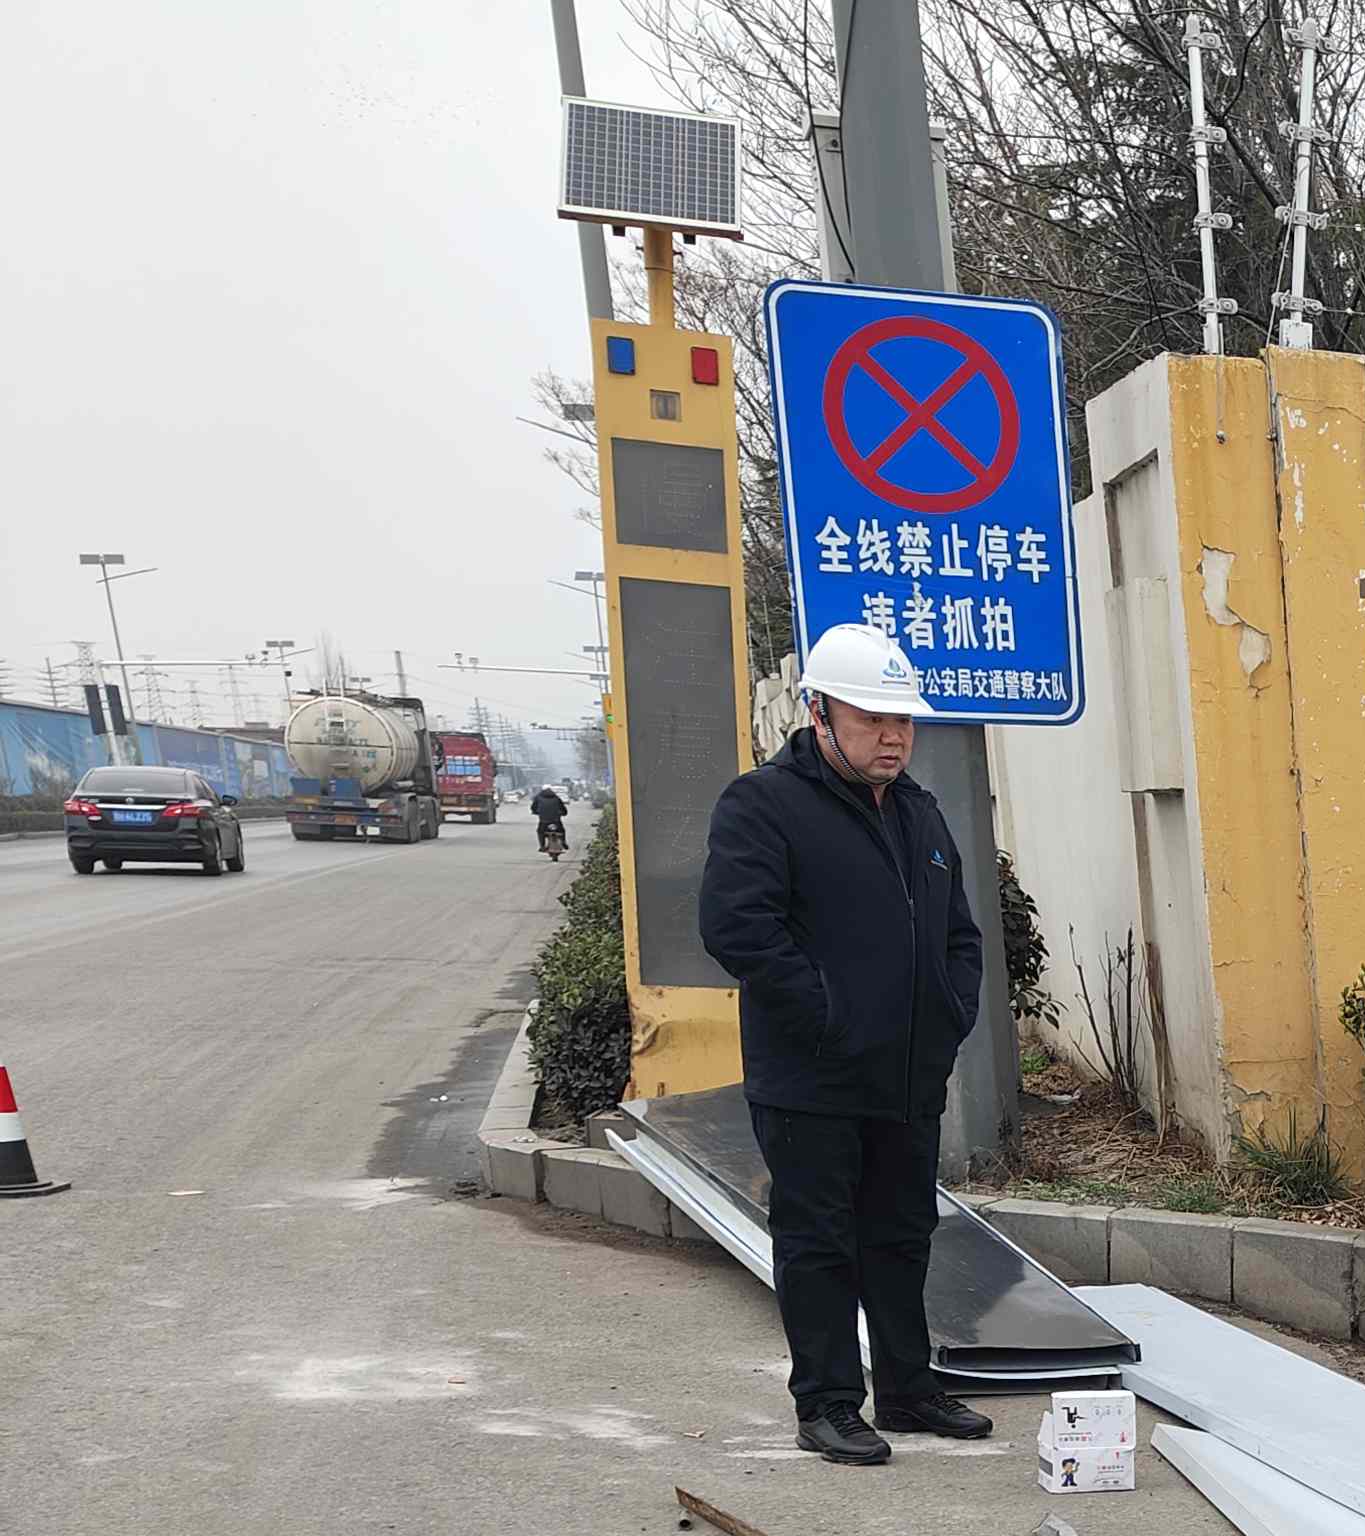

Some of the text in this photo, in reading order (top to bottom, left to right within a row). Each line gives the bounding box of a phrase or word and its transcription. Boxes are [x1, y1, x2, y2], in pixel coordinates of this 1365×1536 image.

[815, 515, 1050, 584] 全线禁止停车
[861, 591, 1016, 651] 违者抓拍
